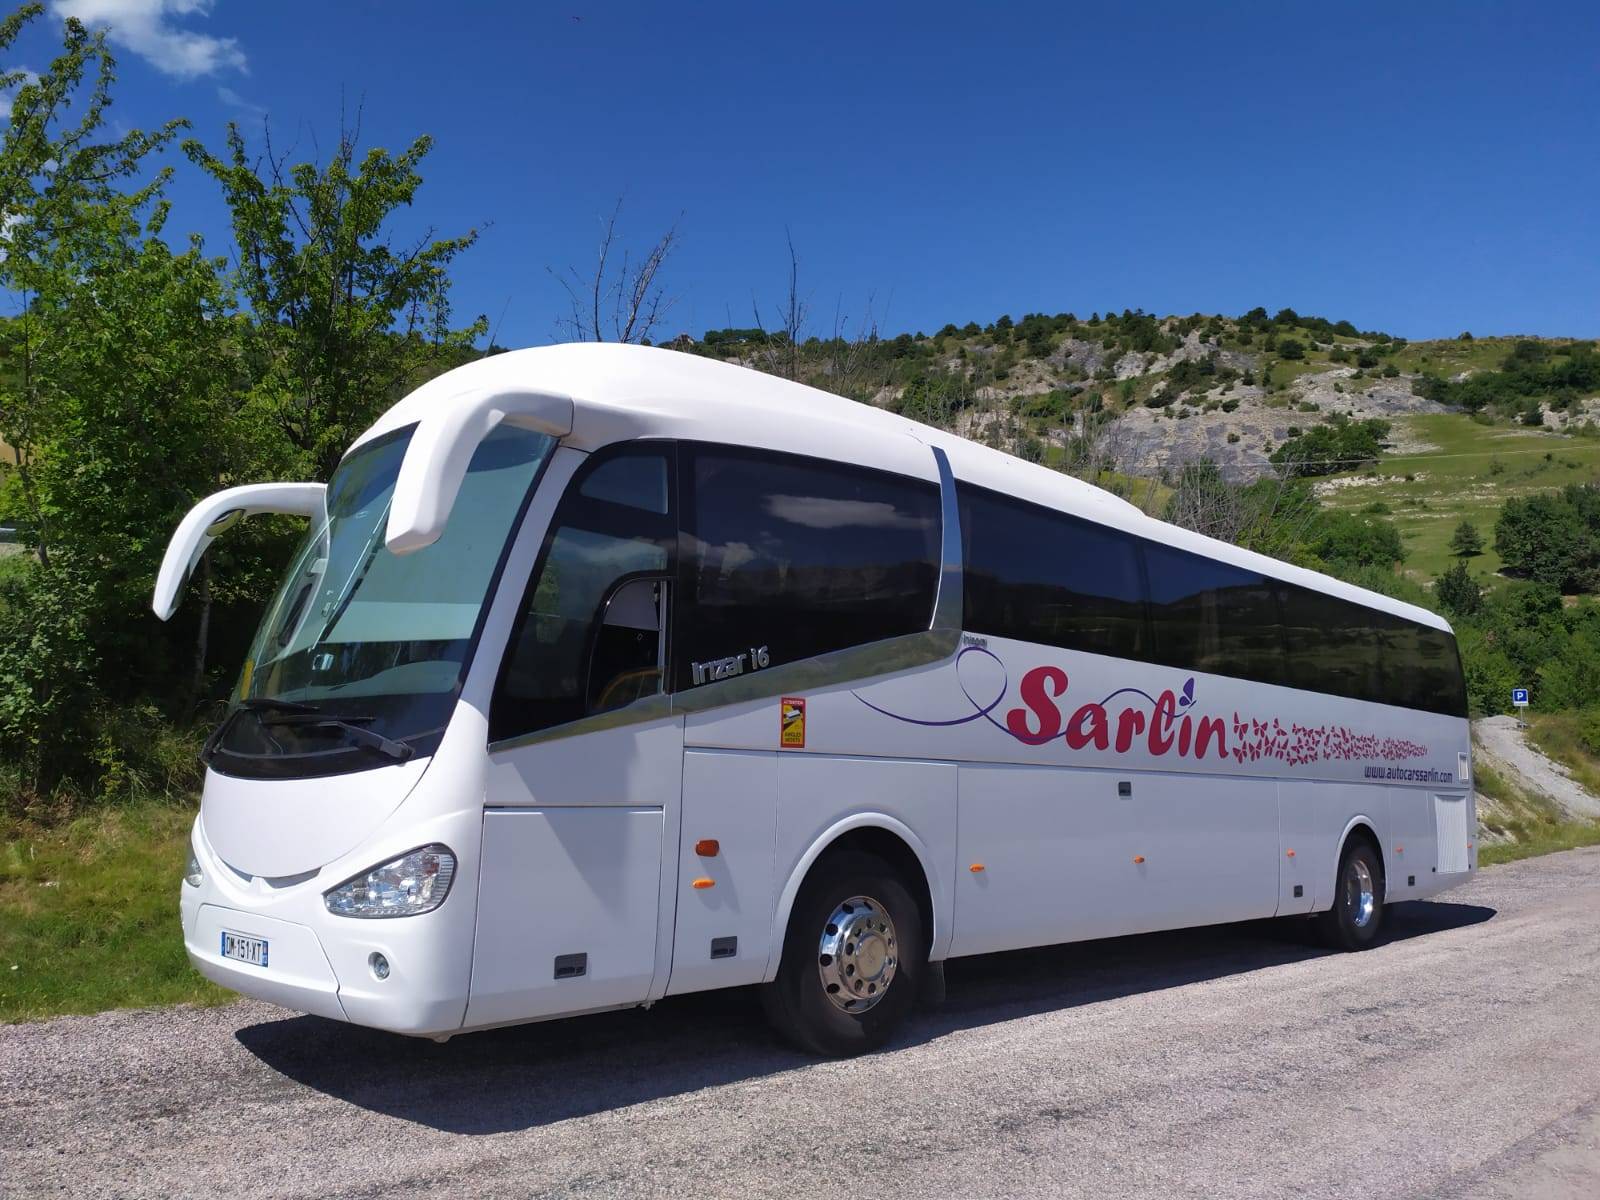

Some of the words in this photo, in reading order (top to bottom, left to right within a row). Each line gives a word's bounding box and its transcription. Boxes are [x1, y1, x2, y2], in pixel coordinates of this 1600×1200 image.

[750, 645, 770, 670] i6
[1516, 691, 1524, 701] P
[1006, 665, 1229, 760] Sarlin
[1364, 765, 1453, 784] www.autocarssarlin.com
